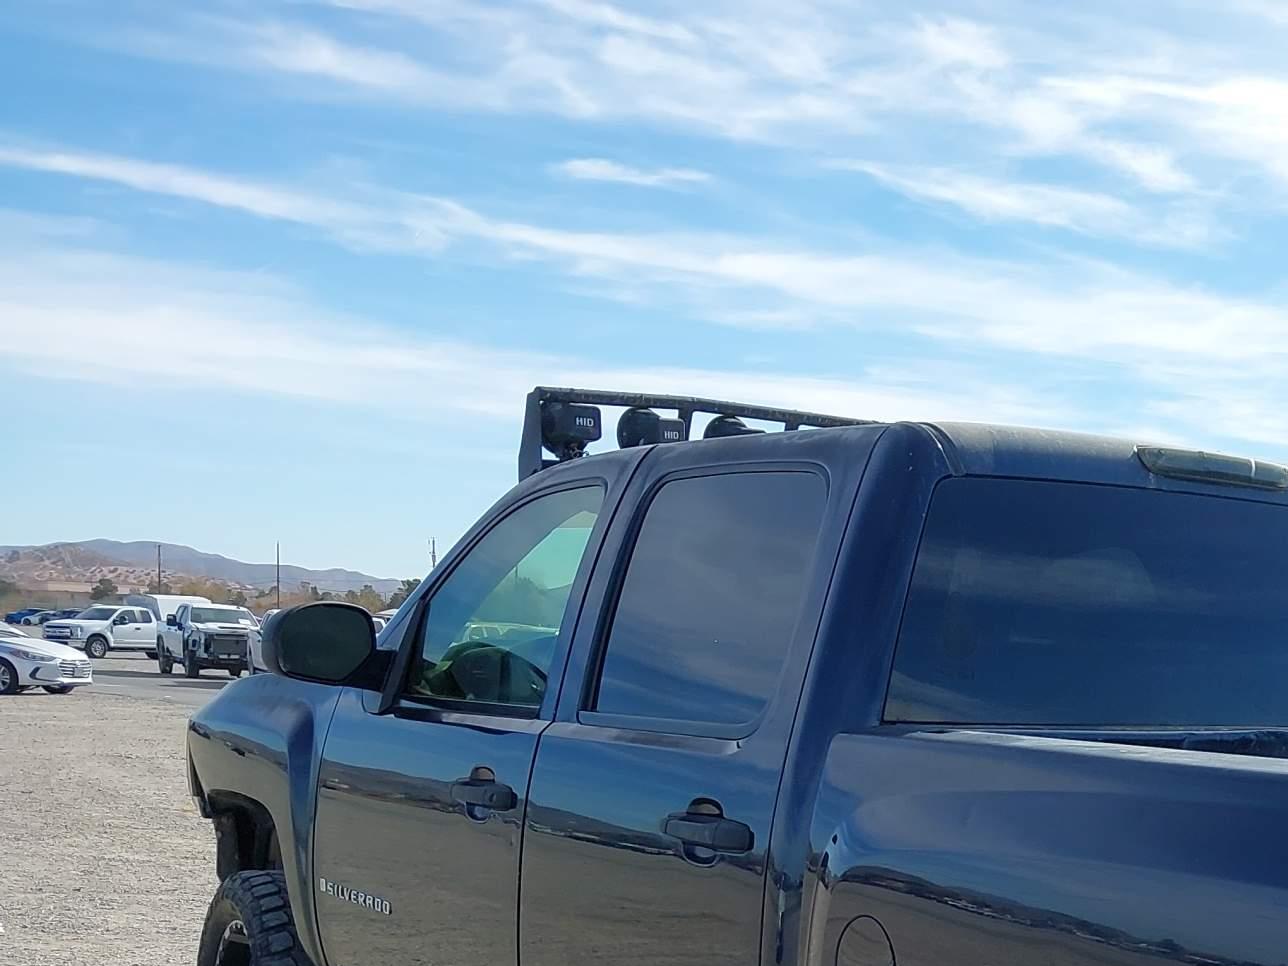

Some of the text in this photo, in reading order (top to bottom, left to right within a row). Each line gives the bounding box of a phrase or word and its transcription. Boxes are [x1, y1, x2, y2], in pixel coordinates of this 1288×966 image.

[576, 417, 594, 427] HID
[664, 431, 679, 440] HID
[327, 882, 391, 915] SILVERADO
